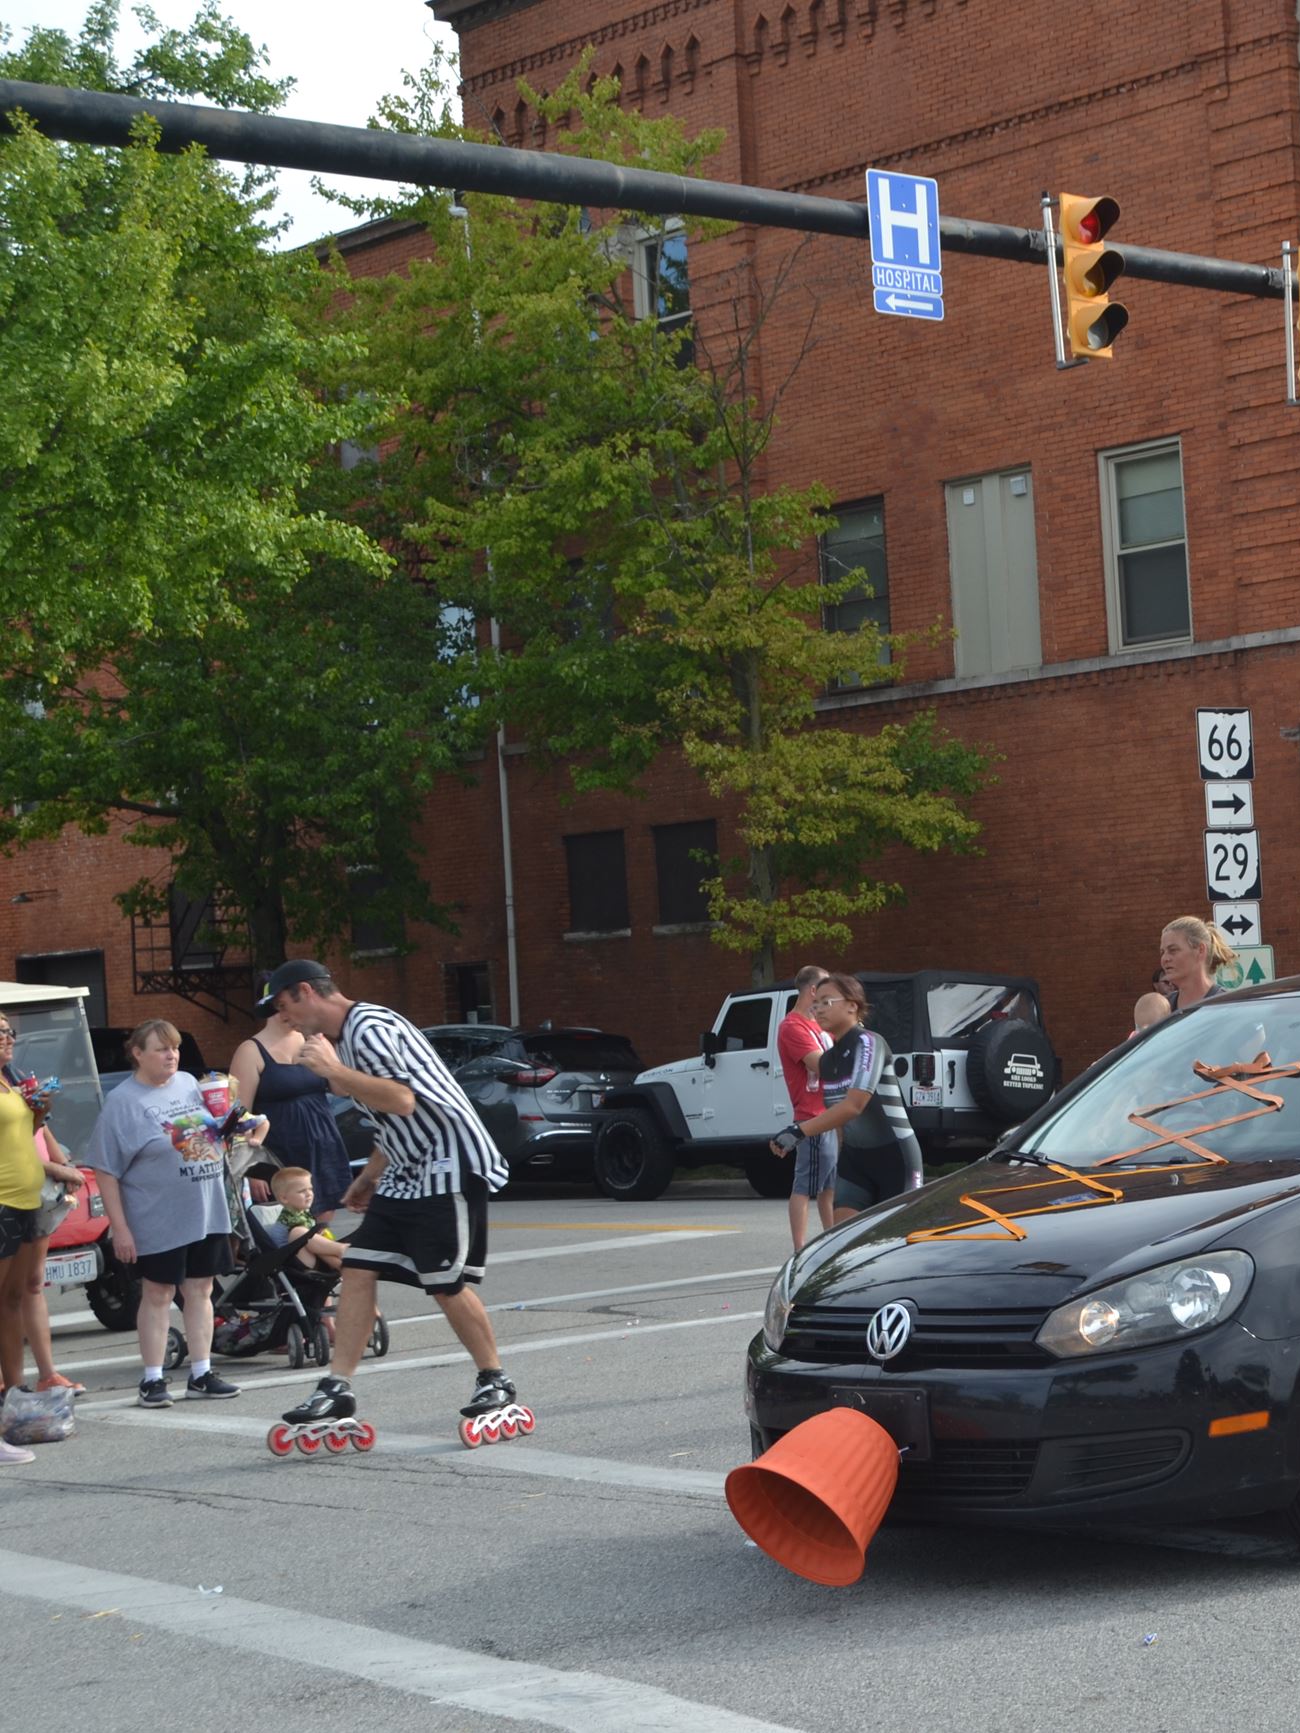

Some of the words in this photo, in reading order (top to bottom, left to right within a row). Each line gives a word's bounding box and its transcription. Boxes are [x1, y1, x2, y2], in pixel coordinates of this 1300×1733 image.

[878, 177, 930, 265] H
[876, 268, 939, 294] HOSPITAL
[1208, 724, 1242, 761] 66
[1213, 843, 1249, 881] 29
[179, 1166, 196, 1177] MY
[45, 1264, 65, 1281] HMU
[68, 1260, 92, 1278] 1837
